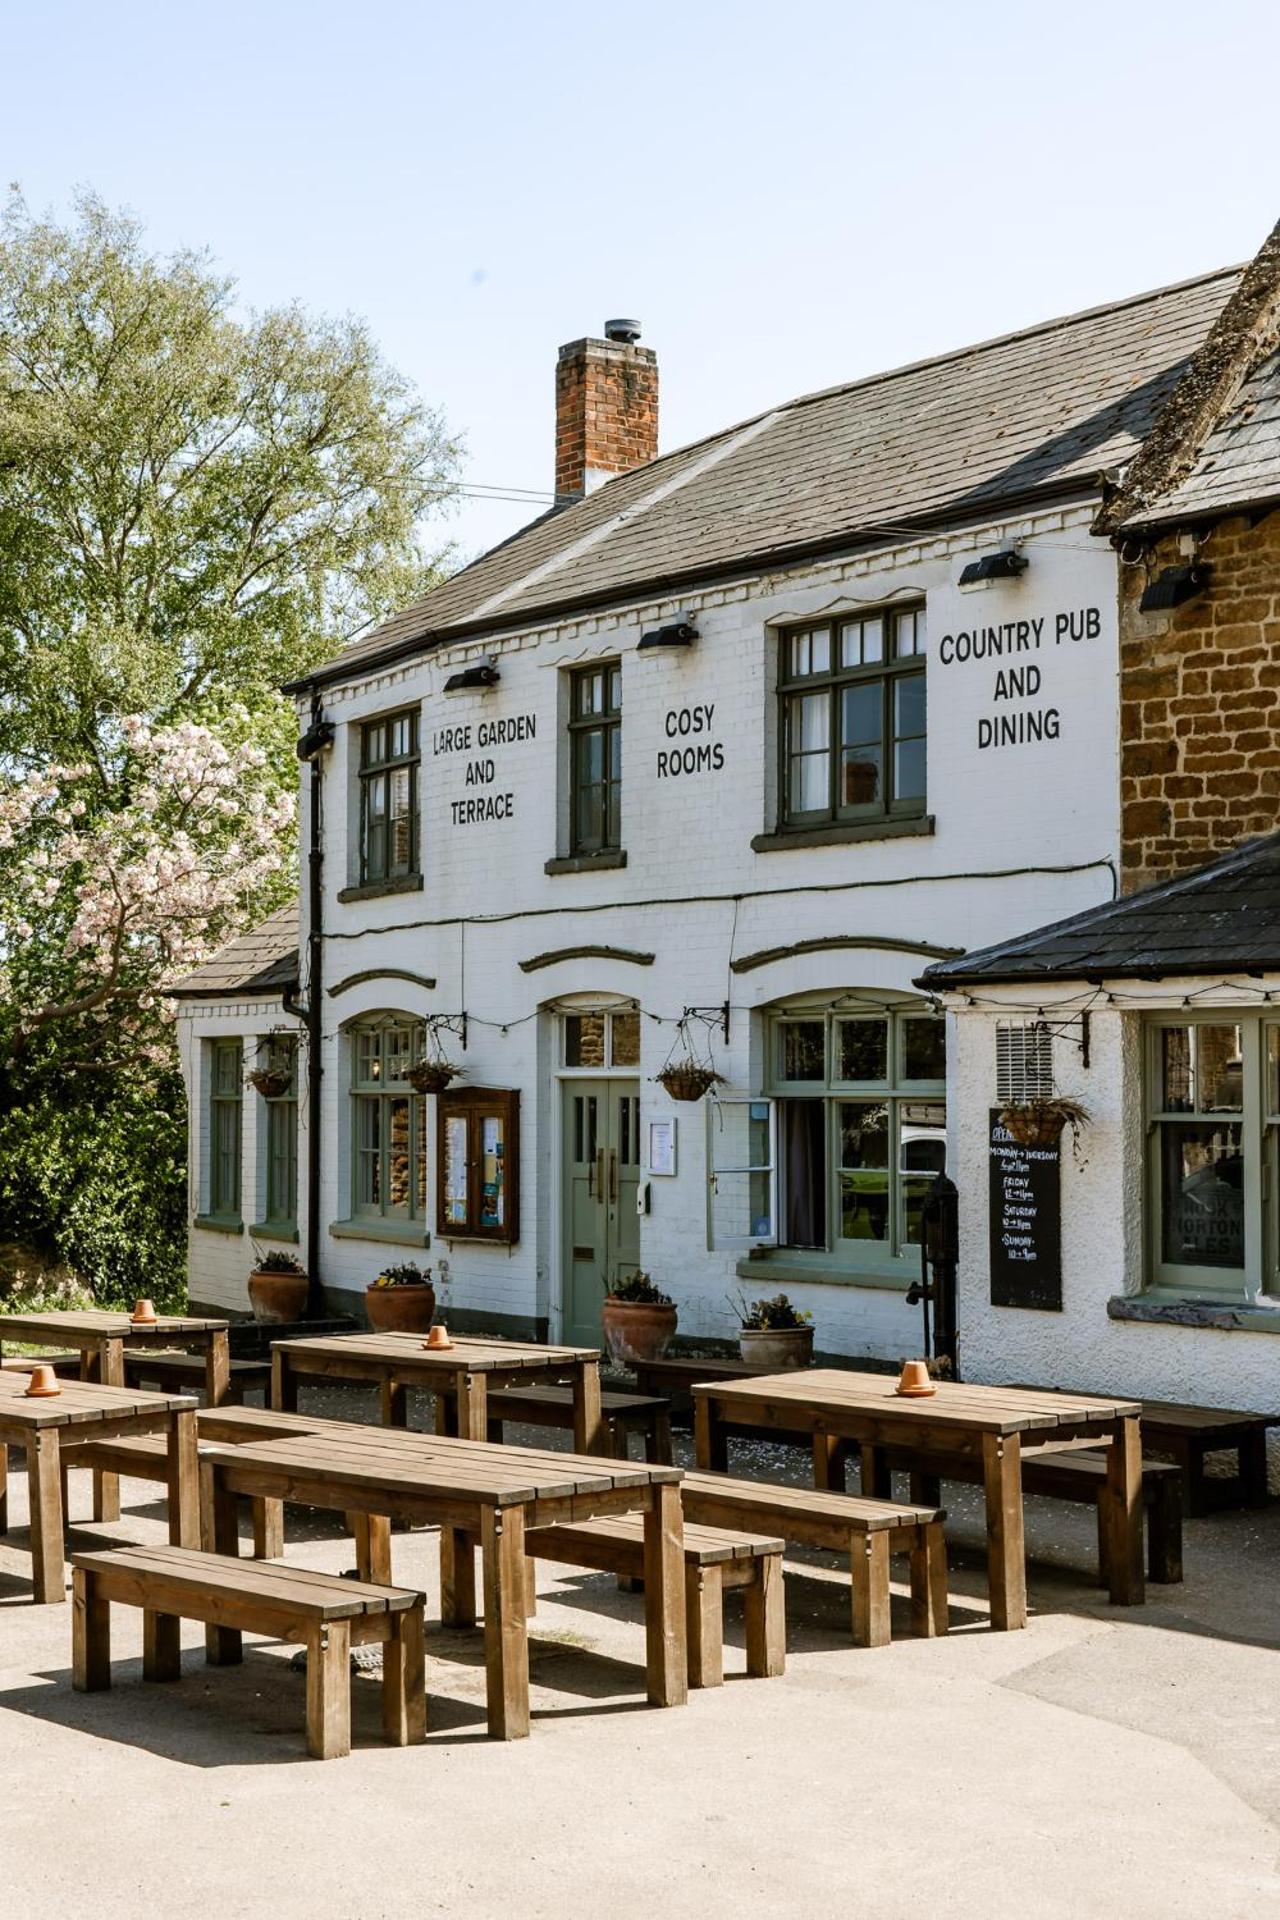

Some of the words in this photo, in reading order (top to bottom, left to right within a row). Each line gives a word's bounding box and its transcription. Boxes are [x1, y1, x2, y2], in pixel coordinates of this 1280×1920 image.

[940, 618, 1044, 668] COUNTRY
[1056, 608, 1100, 644] PUB
[994, 665, 1040, 701] AND
[434, 726, 471, 755] LARGE
[478, 714, 535, 747] GARDEN
[666, 704, 714, 737] COSY
[979, 709, 1059, 749] DINING
[466, 760, 494, 786] AND
[658, 743, 724, 778] ROOMS
[451, 793, 513, 824] TERRACE
[990, 1146, 1018, 1159] MONDAY
[1003, 1176, 1030, 1188] FRIDAY
[1004, 1203, 1037, 1216] SATURDAY
[1004, 1232, 1032, 1247] SUNDAY
